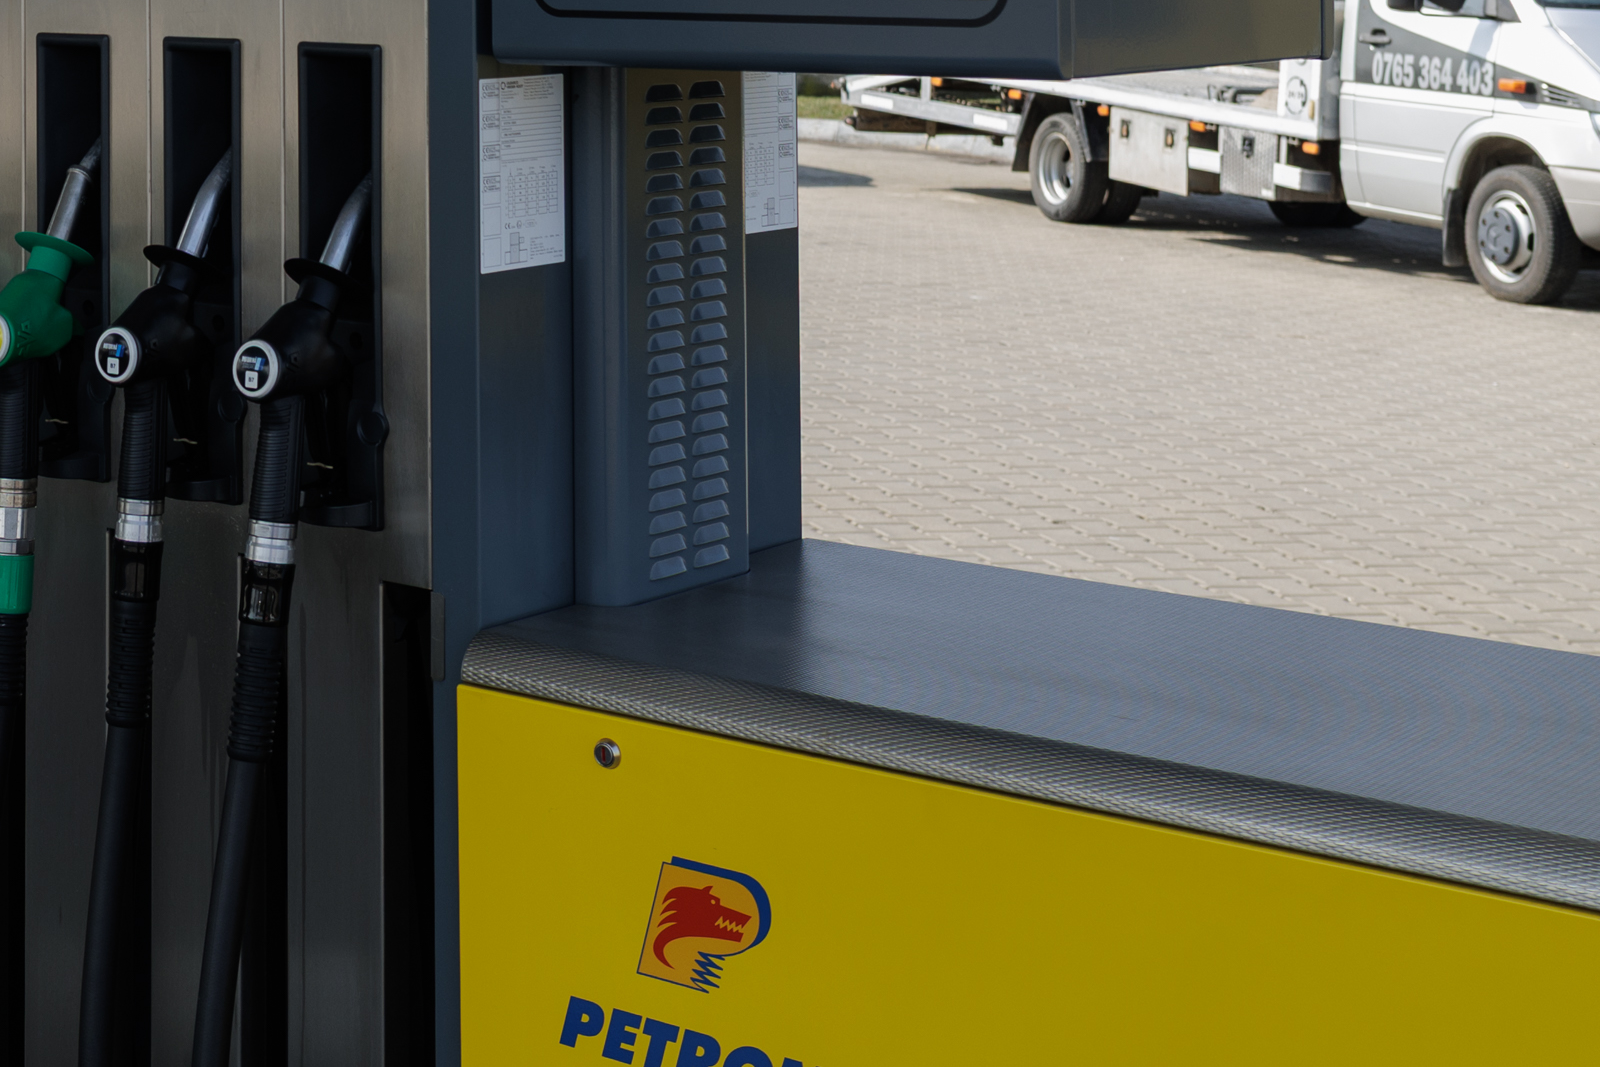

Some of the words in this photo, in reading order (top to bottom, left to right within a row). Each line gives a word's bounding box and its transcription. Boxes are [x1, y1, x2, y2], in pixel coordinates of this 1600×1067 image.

[1372, 51, 1414, 88] 0765
[1418, 55, 1452, 92] 364
[1456, 59, 1494, 96] 403
